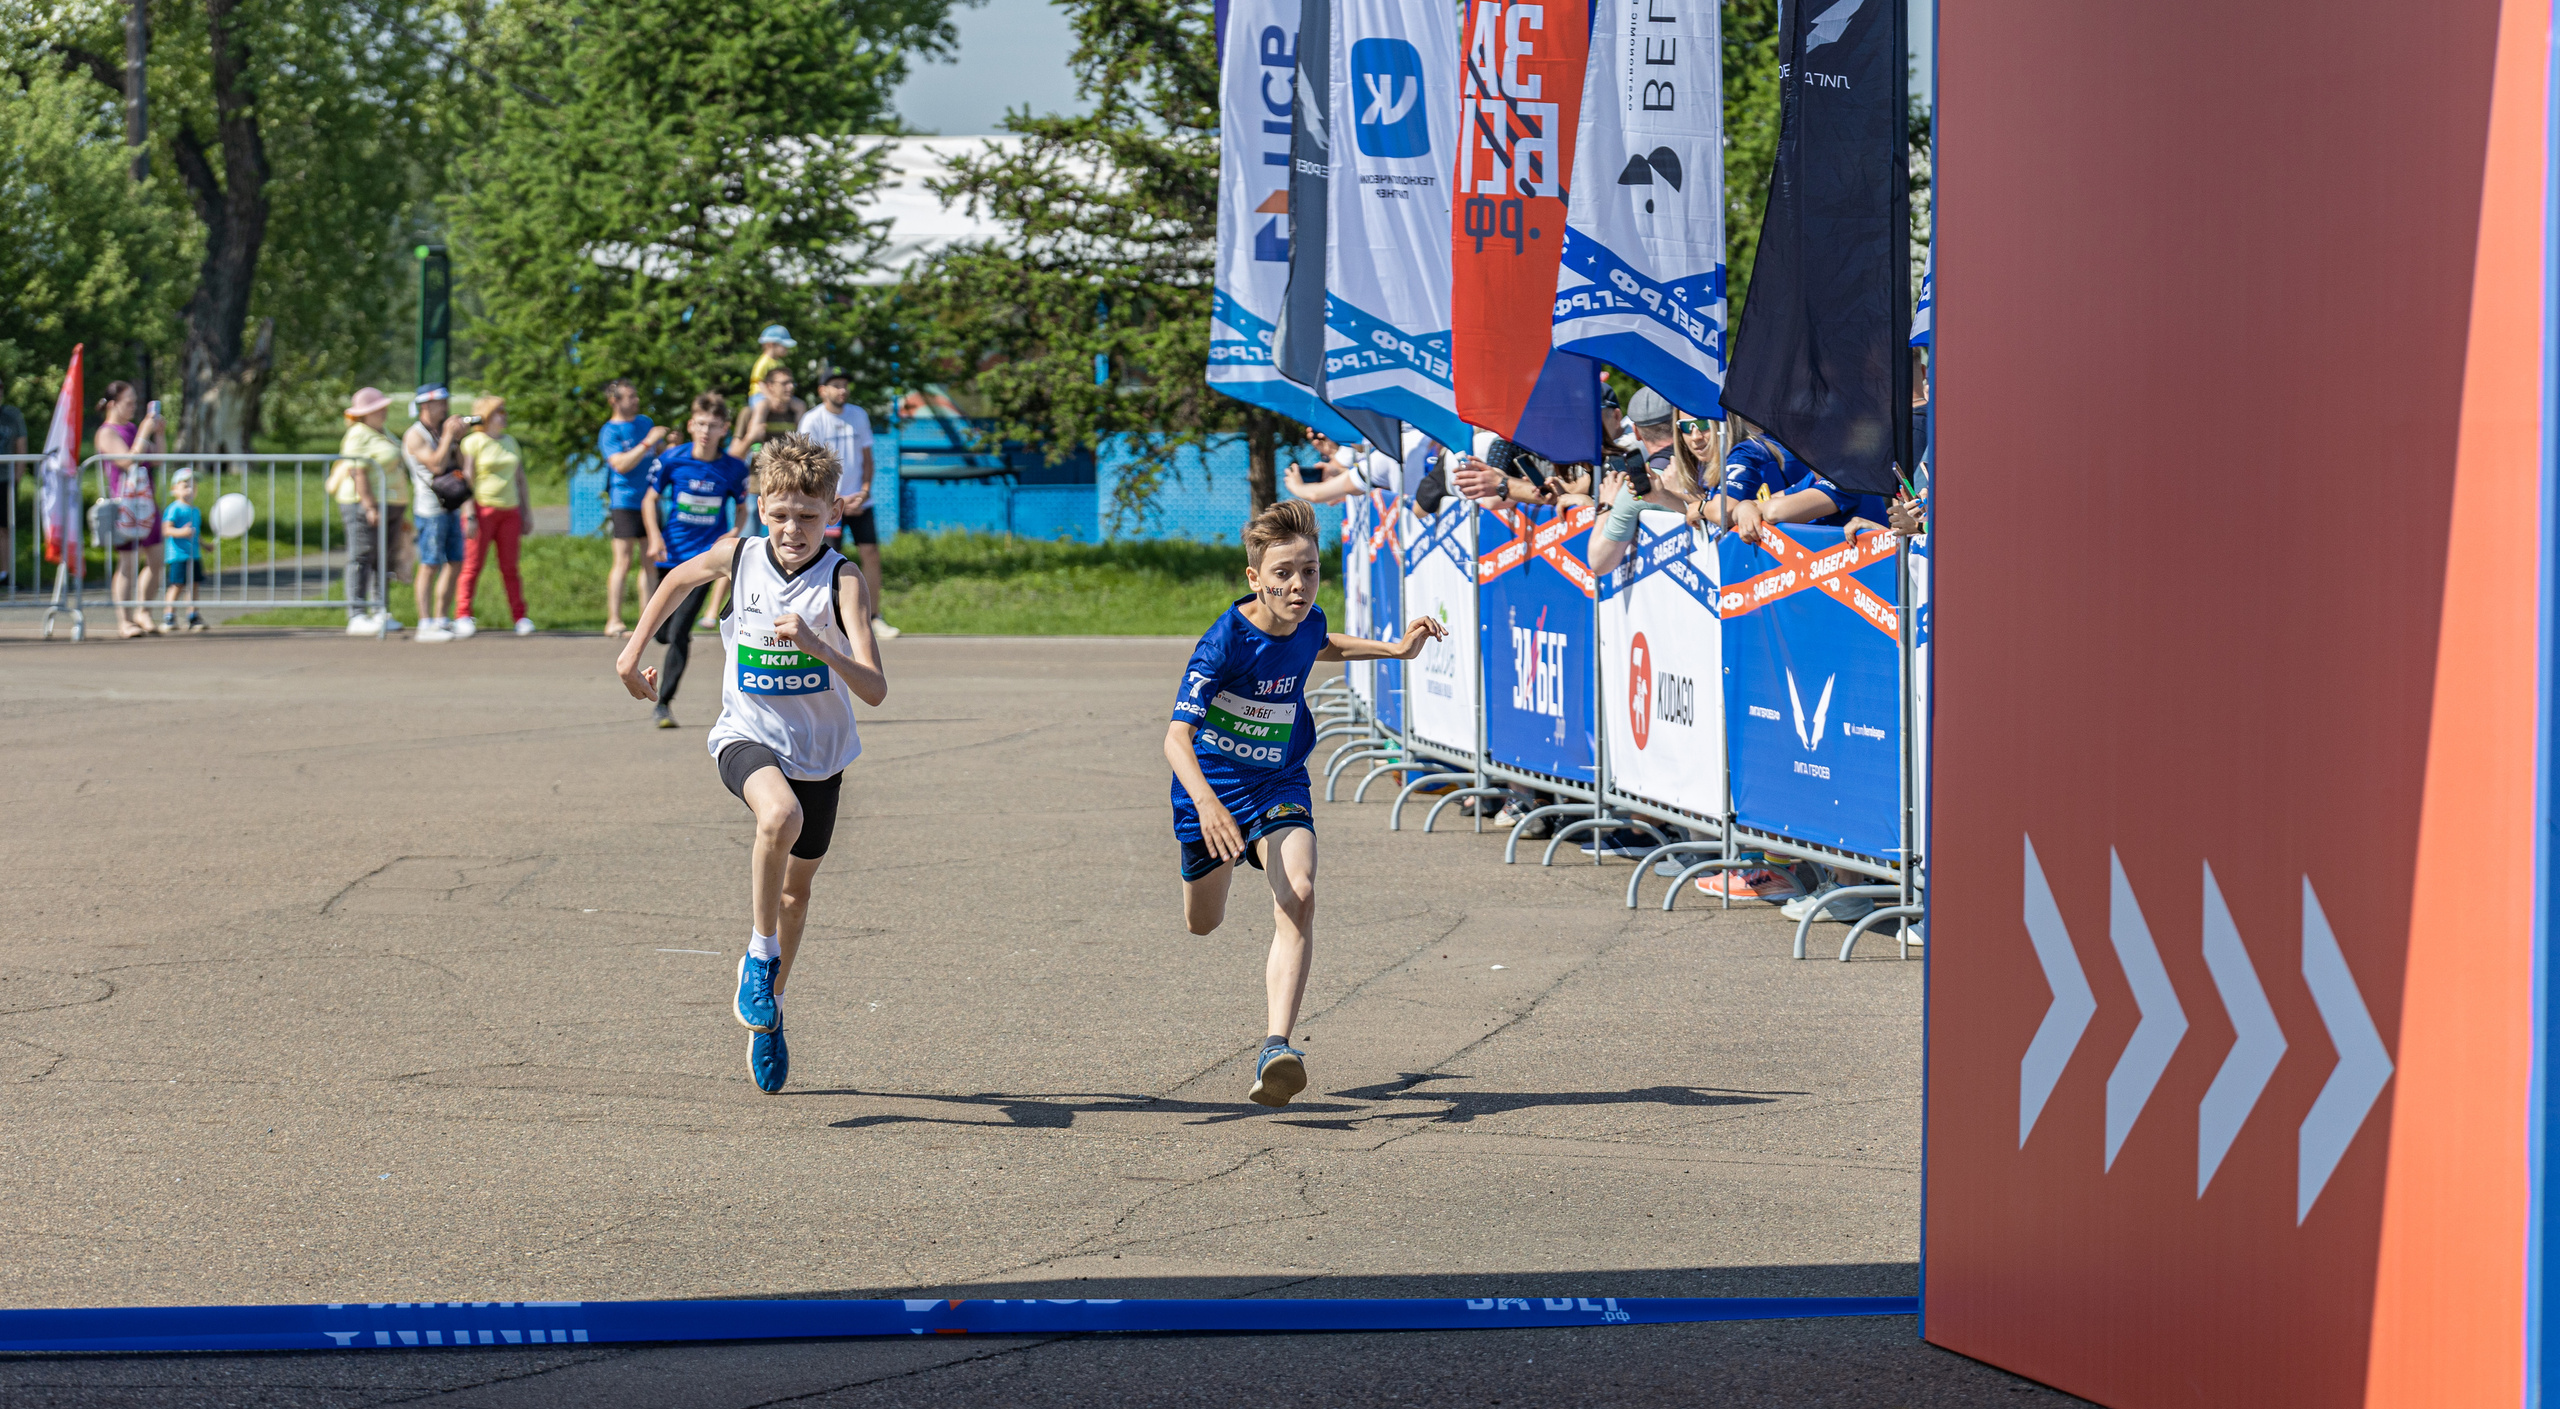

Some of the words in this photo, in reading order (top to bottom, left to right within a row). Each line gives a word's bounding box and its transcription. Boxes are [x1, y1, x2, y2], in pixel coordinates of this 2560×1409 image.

[1809, 546, 1859, 580] ЗАБЕГ.РФ
[1753, 570, 1796, 602] ЗАБЕГ.РФ
[1853, 588, 1897, 630] ЗАБЕГ.РФ
[743, 672, 821, 690] 20190
[1188, 671, 1211, 698] 7
[1175, 701, 1207, 718] 2023
[1657, 671, 1694, 727] KUDAGO
[1202, 729, 1282, 762] 20005
